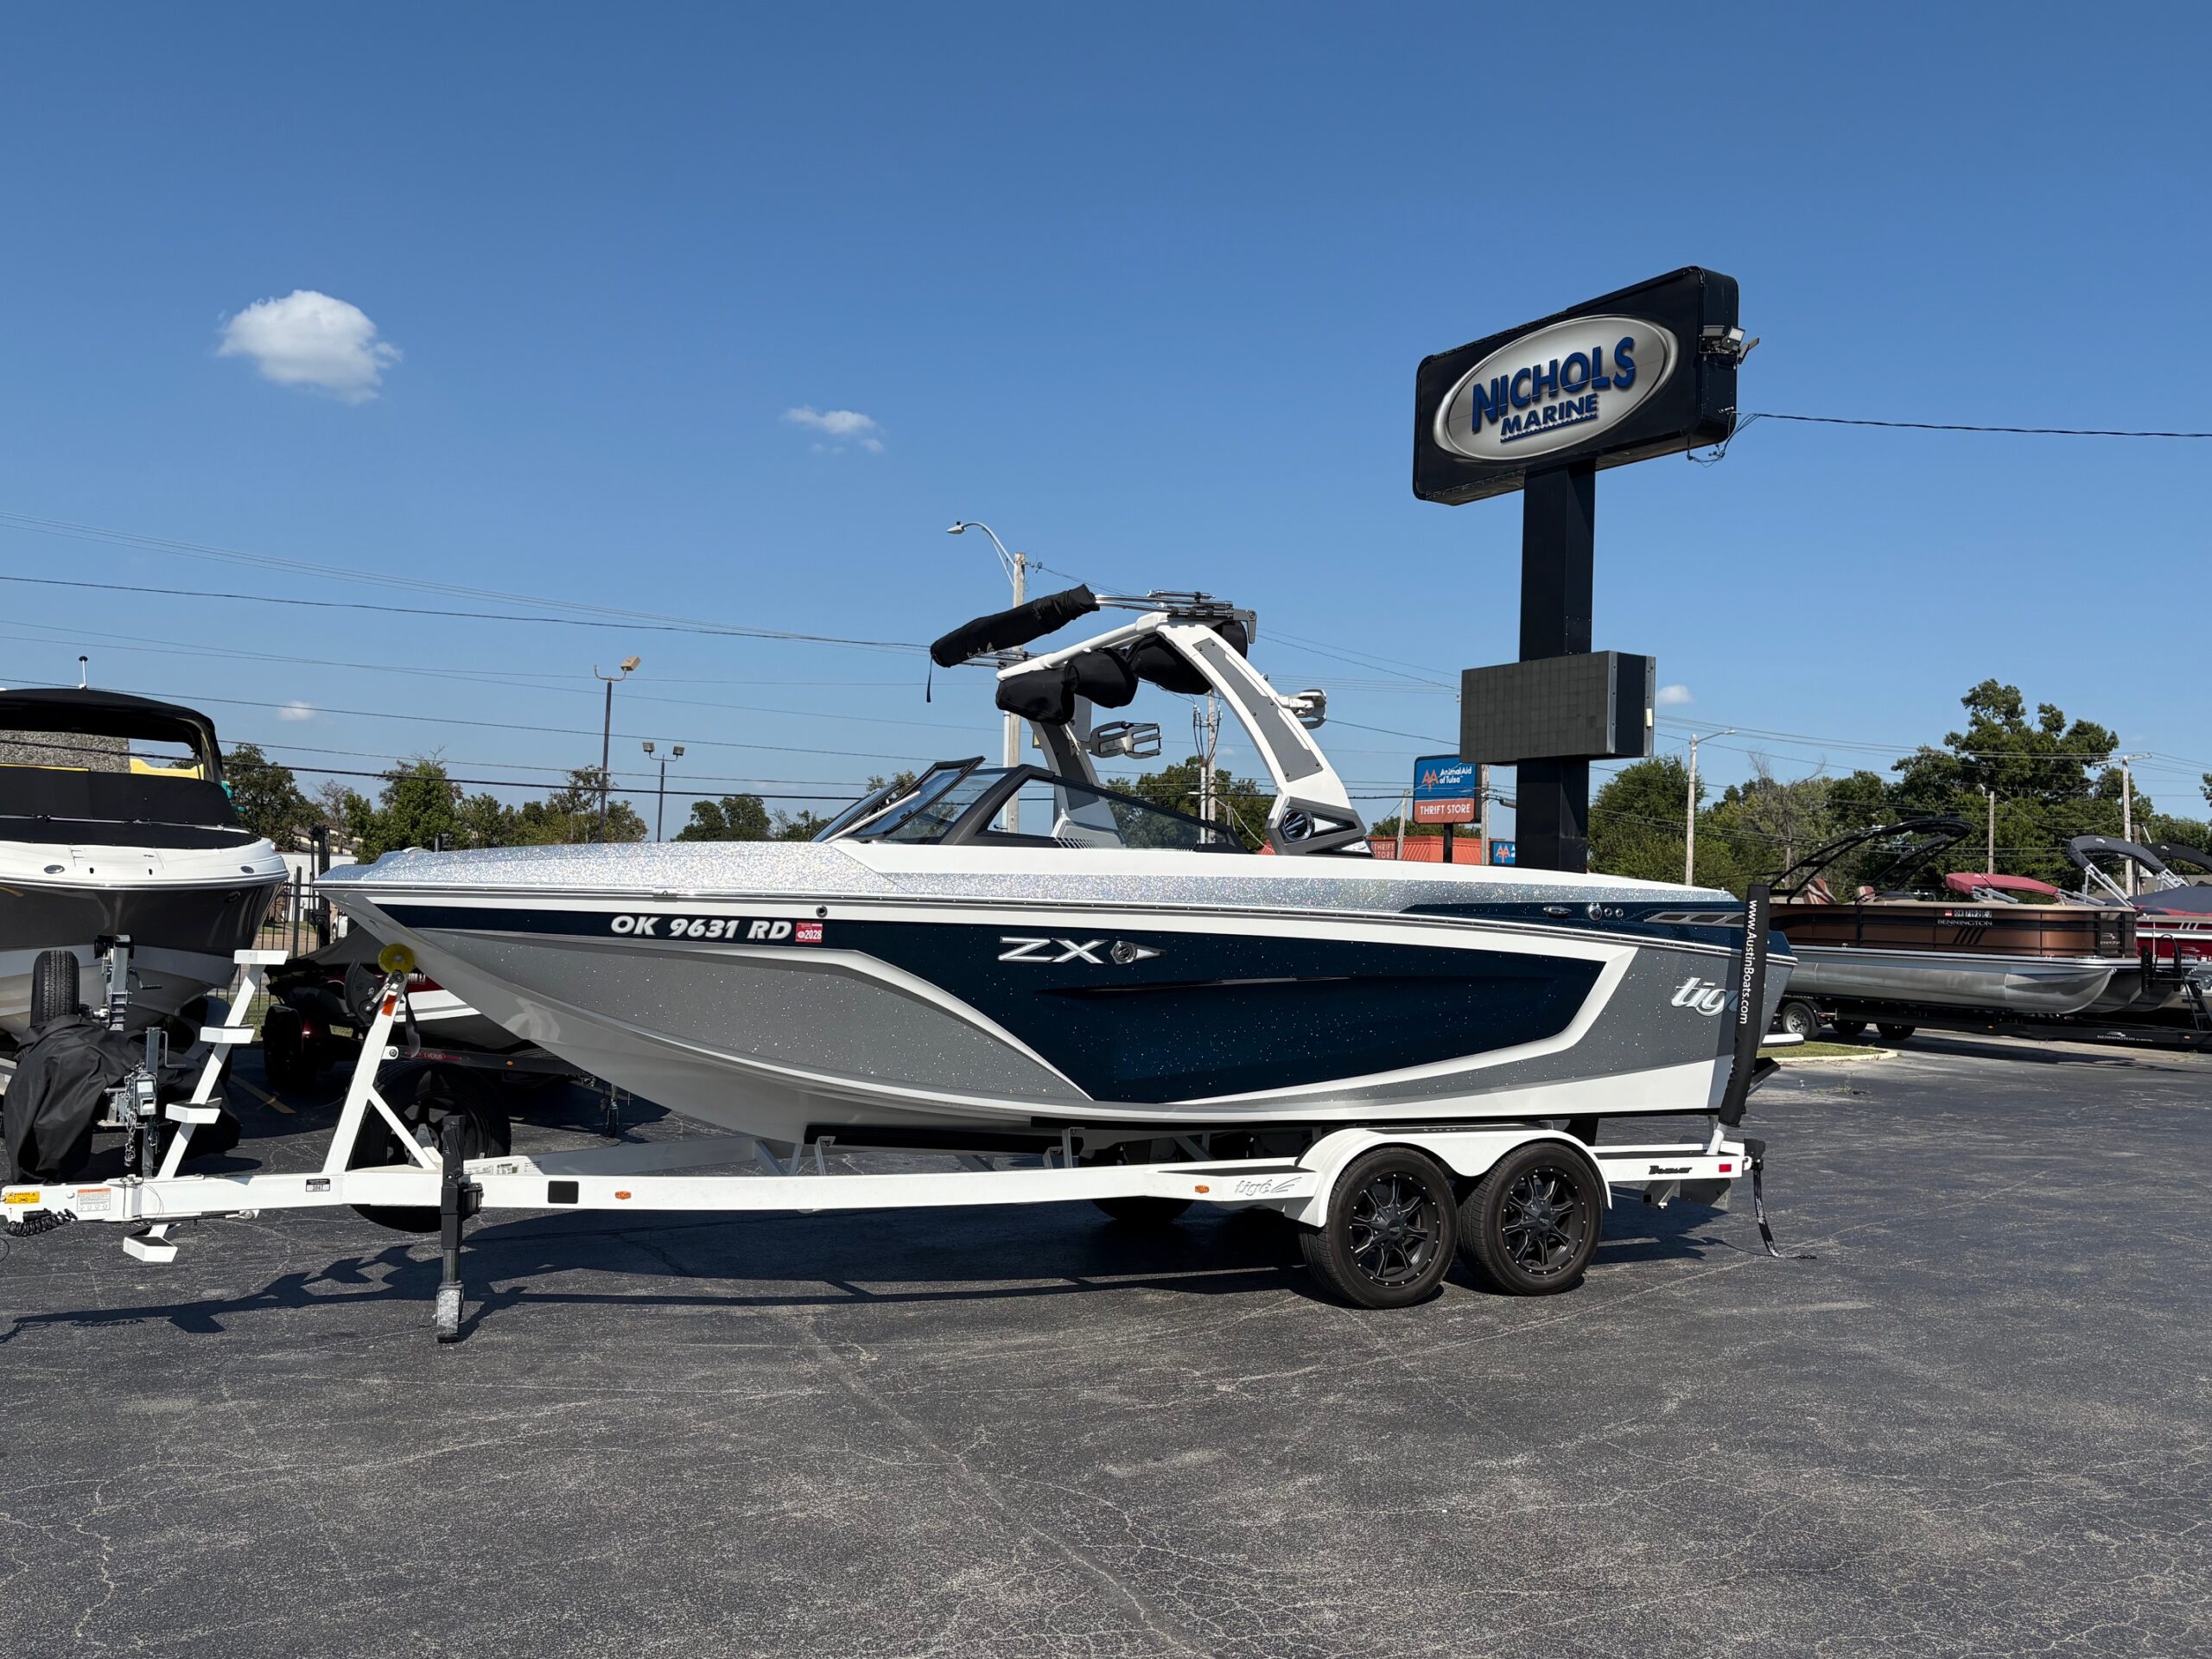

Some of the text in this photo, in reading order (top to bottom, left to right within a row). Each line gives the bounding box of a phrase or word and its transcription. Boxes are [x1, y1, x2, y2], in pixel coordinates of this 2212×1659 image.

[1471, 335, 1636, 433] NICHOLS
[1501, 392, 1599, 435] MARINE
[1440, 766, 1471, 776] Animal Aid
[1420, 804, 1471, 815] THRIFT STORE
[1374, 842, 1395, 851] THRIFT
[610, 915, 791, 939] OK 9631 RD
[804, 930, 822, 940] 2028
[997, 936, 1109, 964] ZX
[1739, 899, 1758, 1024] www.AustinBoats.com
